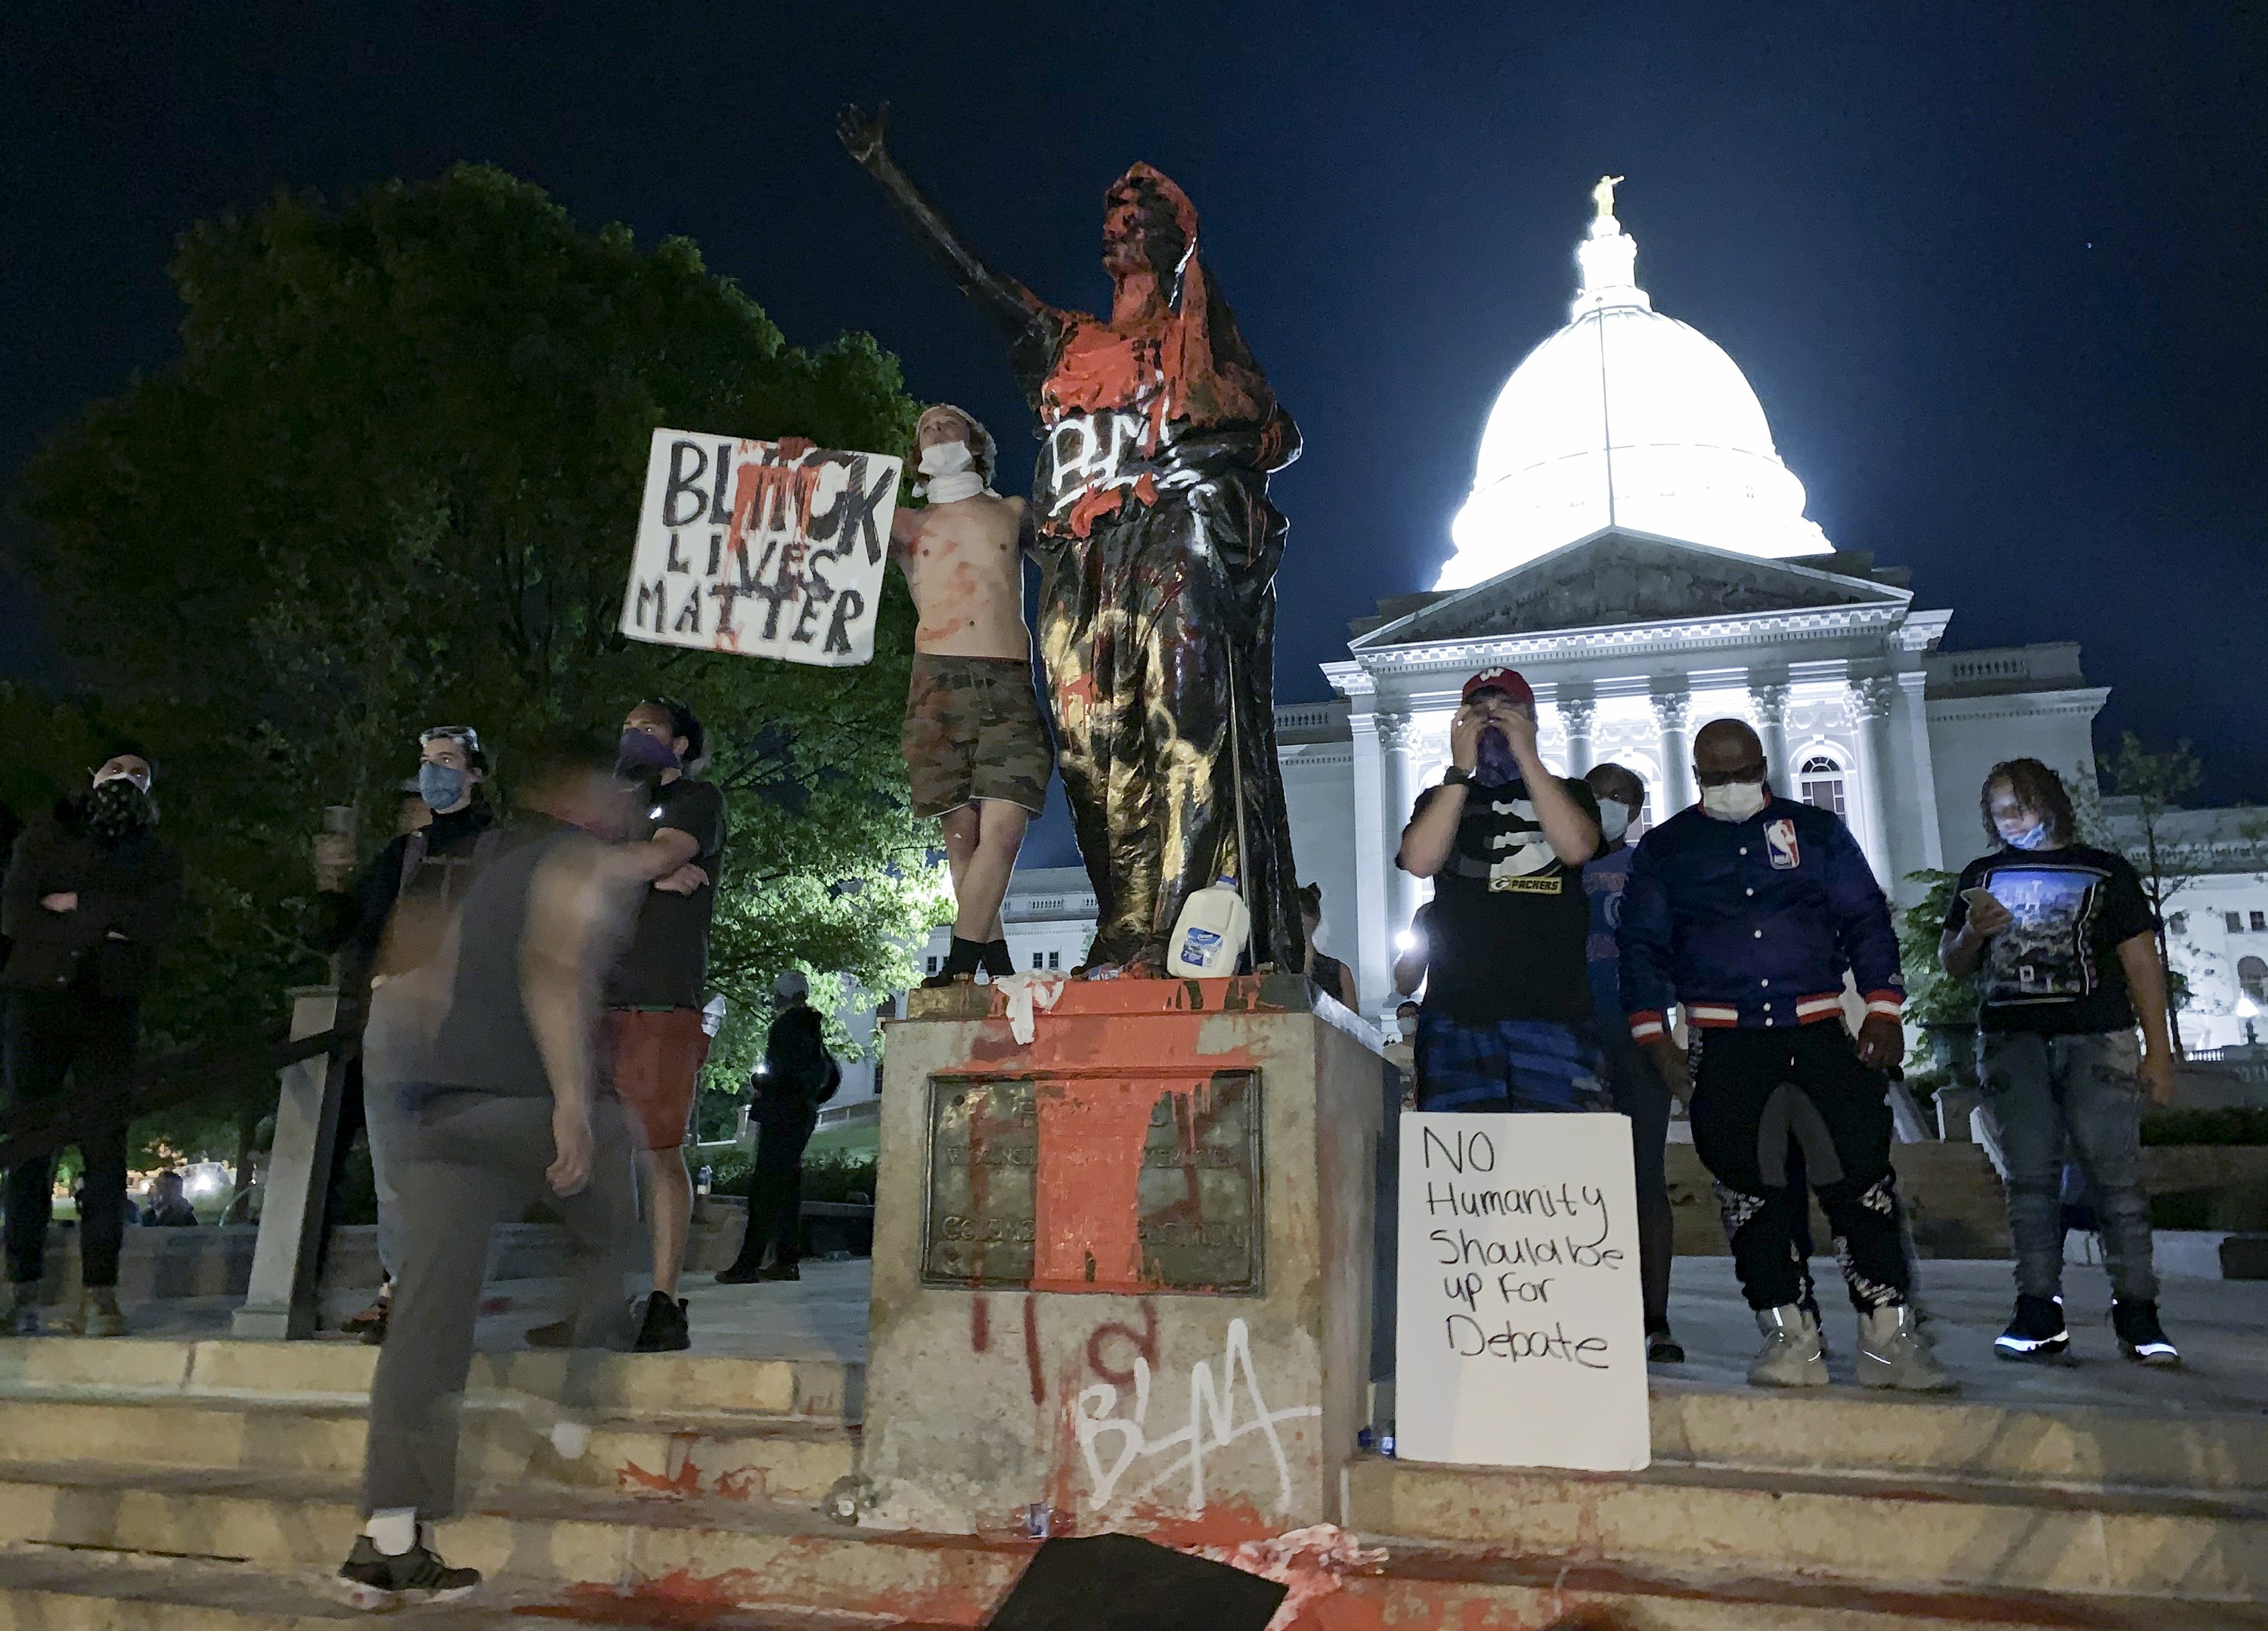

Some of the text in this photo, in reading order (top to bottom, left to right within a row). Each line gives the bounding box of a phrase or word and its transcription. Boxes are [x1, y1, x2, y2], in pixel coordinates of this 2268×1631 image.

[637, 578, 865, 655] MATTER
[1512, 880, 1560, 891] PACKERS
[1424, 1125, 1495, 1174] NO
[1426, 1181, 1609, 1248] Humanity
[1565, 1235, 1625, 1270] be
[1443, 1272, 1483, 1313] up
[1446, 1314, 1610, 1369] Debate
[1078, 1319, 1321, 1517] BLM
